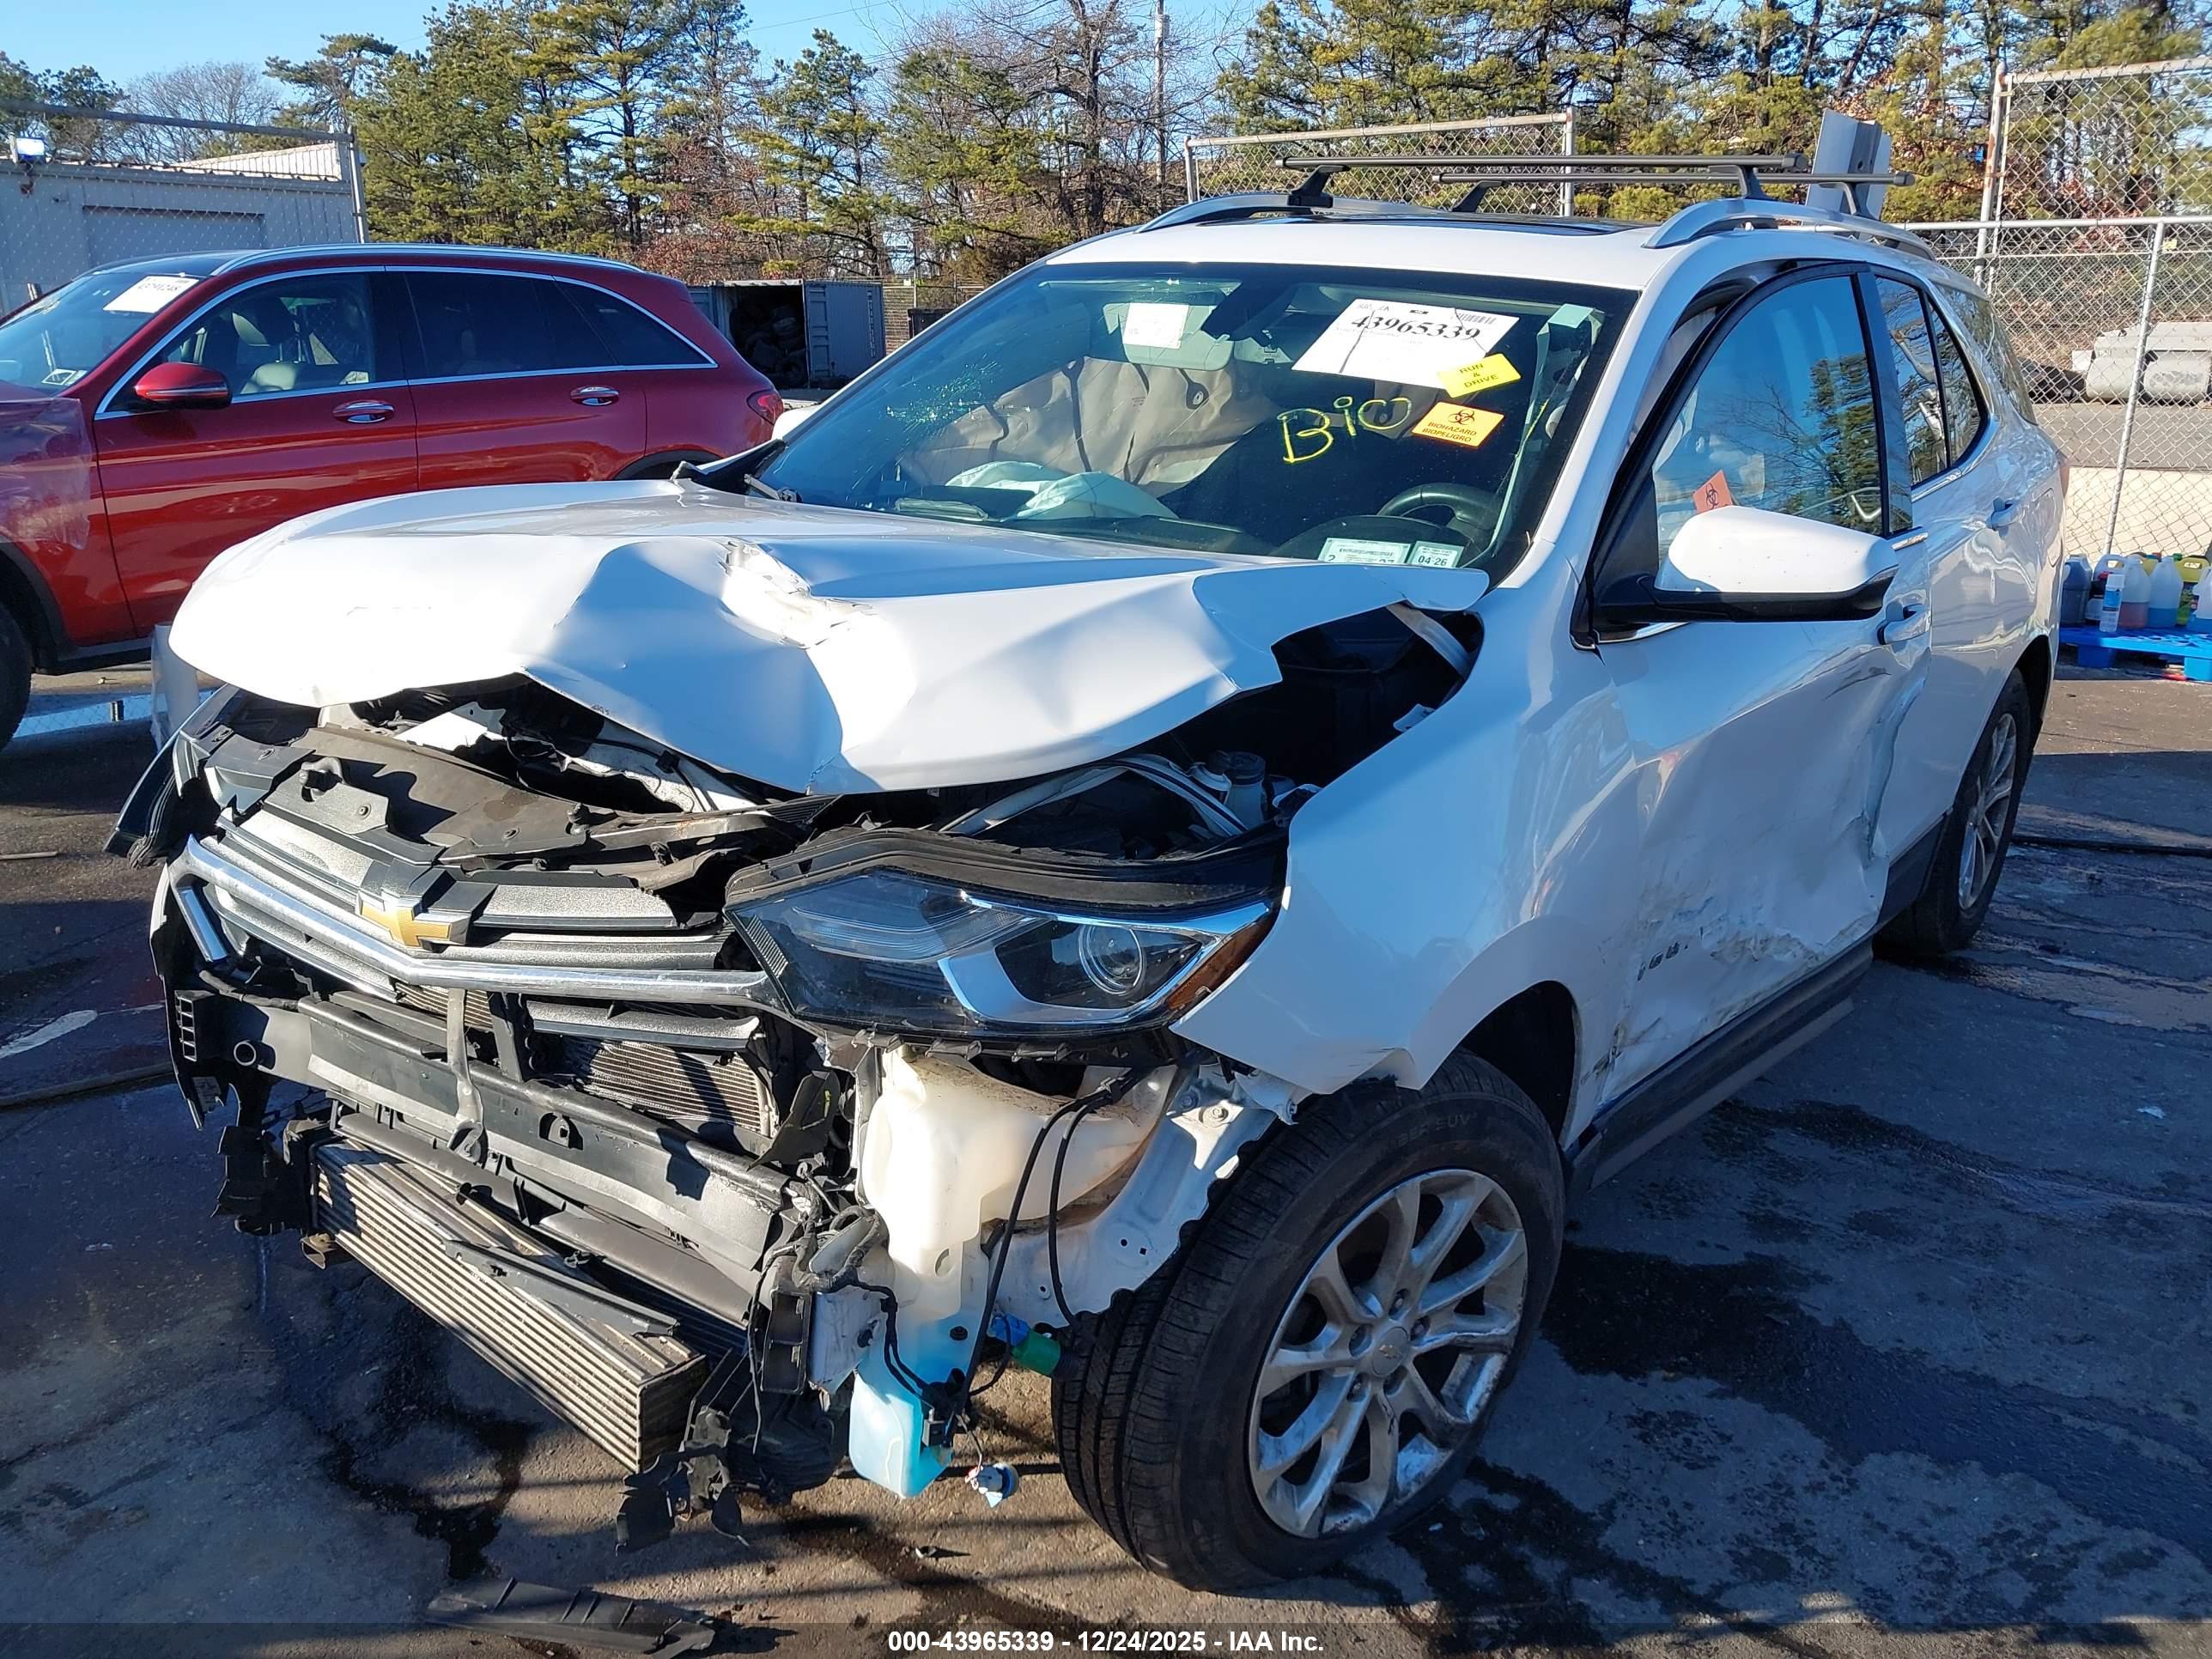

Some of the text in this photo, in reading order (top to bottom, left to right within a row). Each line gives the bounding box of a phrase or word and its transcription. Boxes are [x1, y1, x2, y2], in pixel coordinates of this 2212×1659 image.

[1351, 314, 1481, 341] 43965339
[1459, 363, 1484, 374] RUN
[1463, 374, 1499, 388] DRIVE
[1422, 428, 1472, 442] BIOPELIGRO
[1427, 421, 1477, 436] BIOHAZARD
